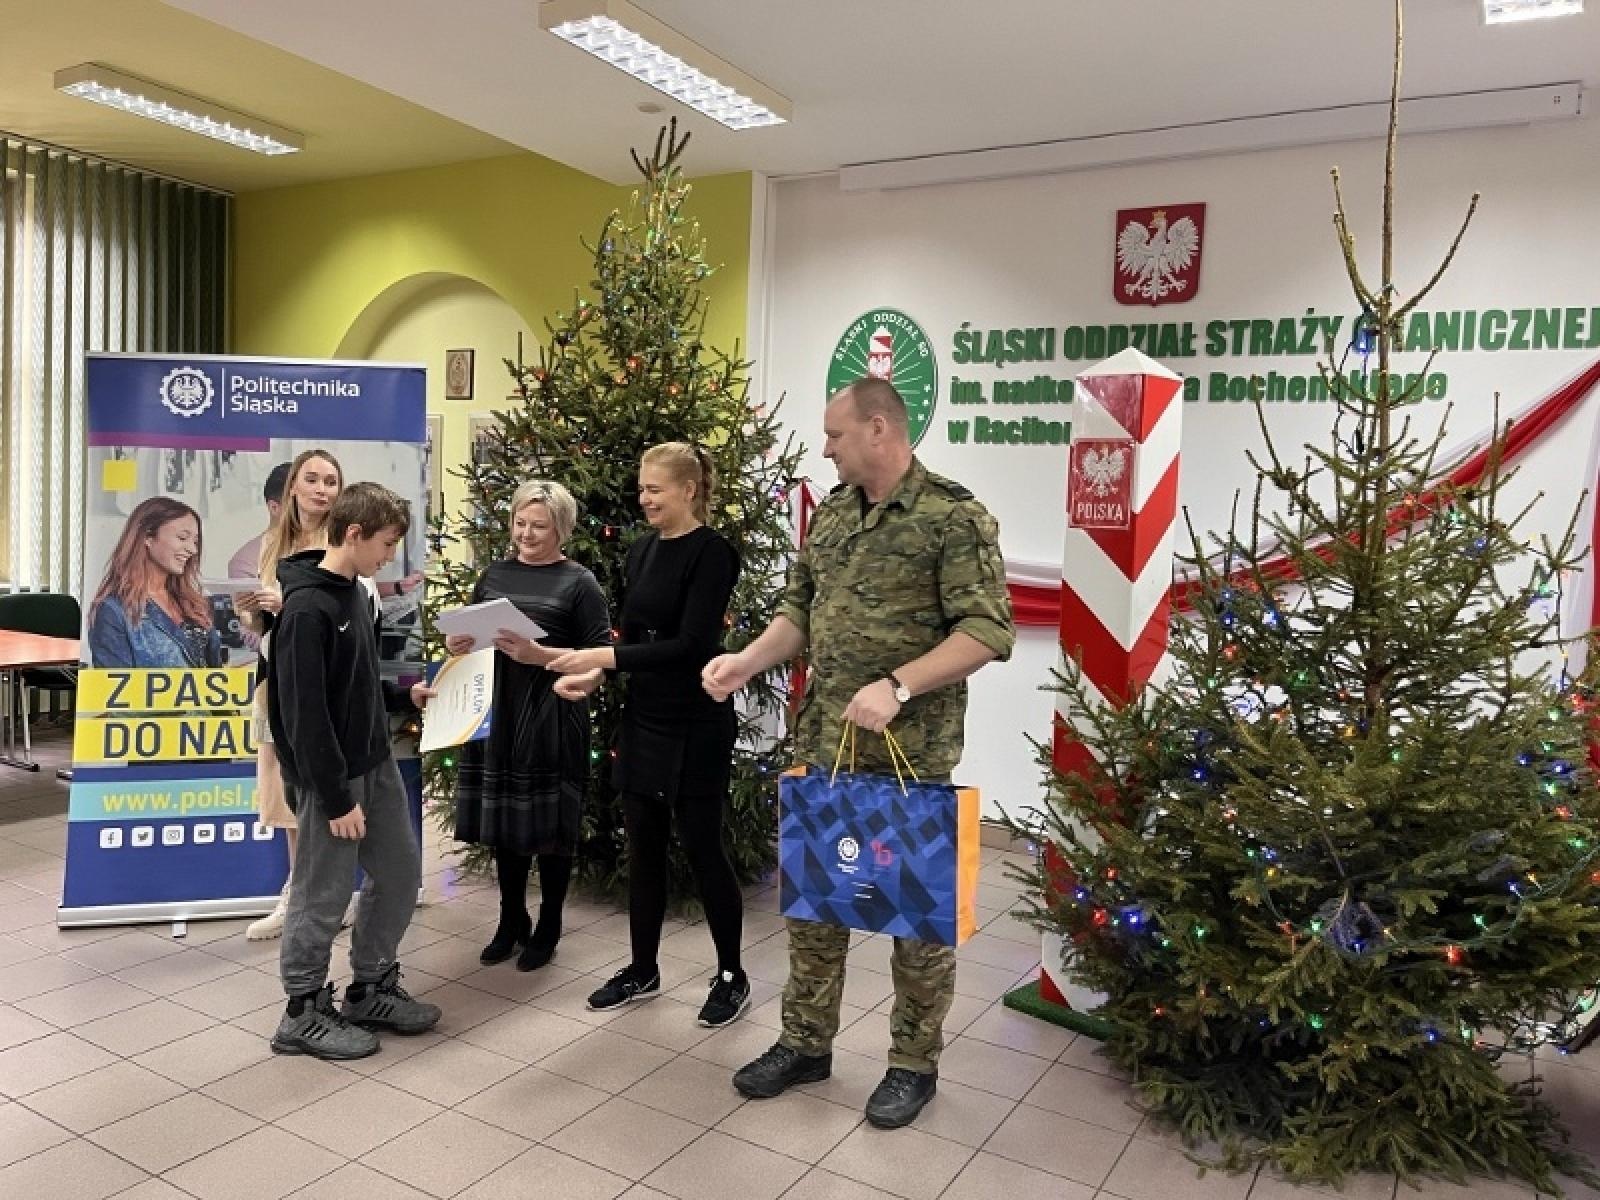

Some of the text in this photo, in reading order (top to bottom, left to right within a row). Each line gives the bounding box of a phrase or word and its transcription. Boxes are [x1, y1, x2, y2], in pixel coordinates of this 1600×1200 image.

[952, 321, 1056, 368] ŚLĄSKI
[1063, 321, 1197, 361] ODDZIAŁ
[1205, 307, 1344, 357] STRAŻY
[231, 375, 360, 397] Politechnika
[950, 376, 987, 404] im.
[992, 375, 1075, 404] nadko
[231, 391, 299, 414] Śląska
[947, 419, 969, 444] w
[1076, 502, 1123, 521] POLSKA
[107, 671, 255, 709] Z PASJ
[103, 718, 259, 759] DO NAU
